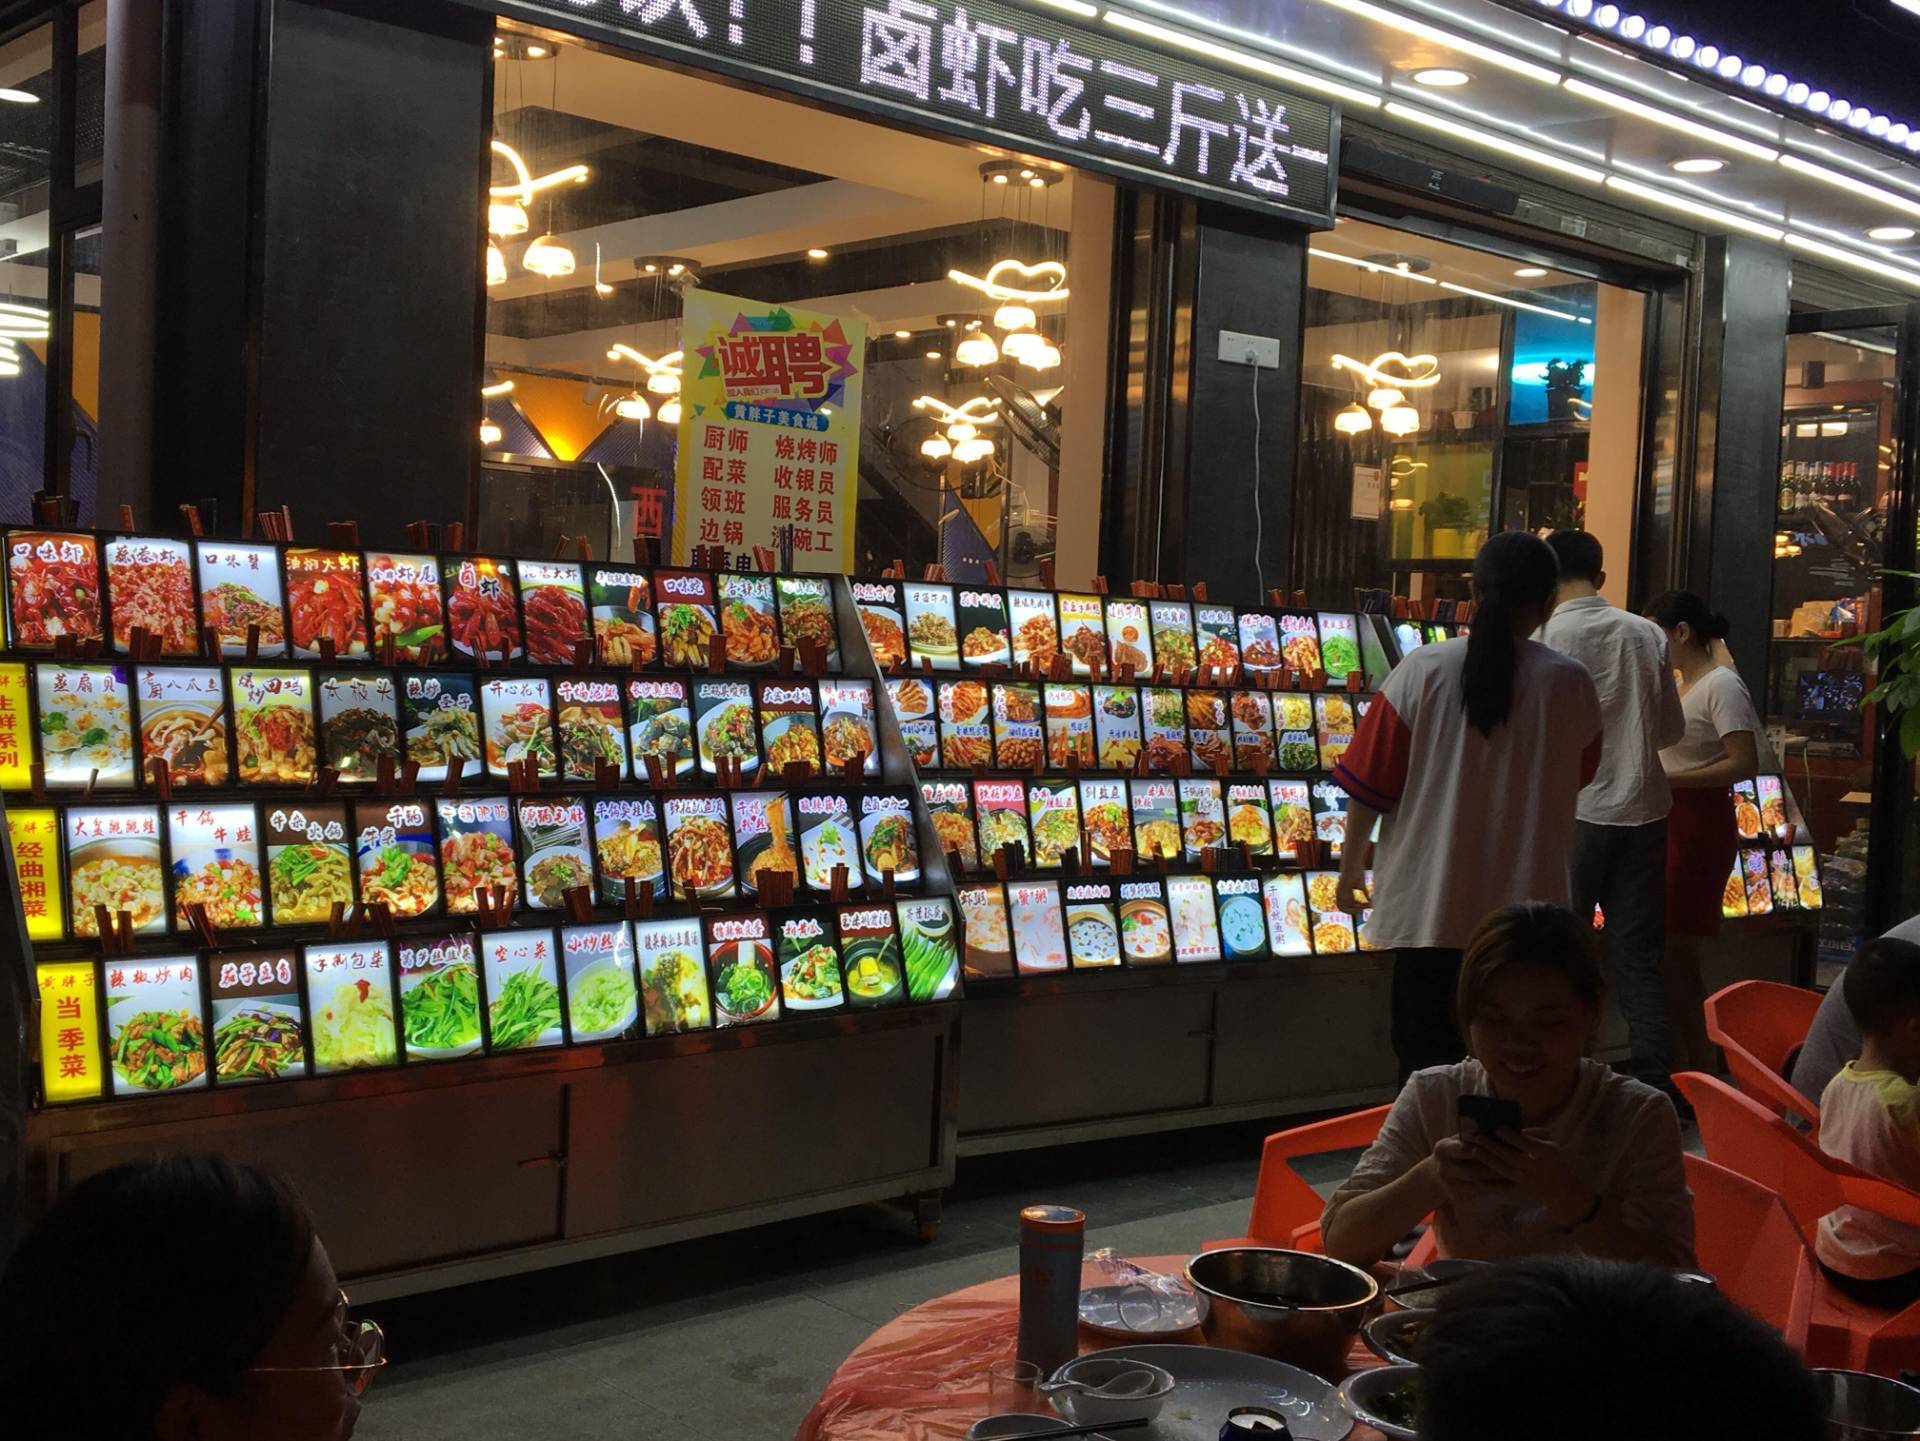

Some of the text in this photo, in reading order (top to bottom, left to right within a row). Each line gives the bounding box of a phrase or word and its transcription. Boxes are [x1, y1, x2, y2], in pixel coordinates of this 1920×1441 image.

[717, 332, 832, 396] 诚聘
[733, 404, 820, 430] 黄胖子美食城
[704, 424, 749, 455] 厨师
[775, 434, 838, 467] 烧烤师
[703, 455, 747, 485] 配菜
[774, 464, 835, 496] 收银员
[701, 486, 746, 515] 领班
[772, 495, 834, 525] 服务员
[700, 517, 744, 547] 边锅
[14, 542, 83, 565] 口味虾
[114, 546, 178, 565] 蒜蓉虾
[204, 553, 260, 570] 口味蟹
[286, 552, 361, 574] 油焖大虾
[53, 672, 116, 694] 蒸扇贝
[489, 681, 546, 699] 开心花甲
[74, 816, 157, 837] 大盆跳跳蛙
[175, 809, 253, 844] 干锅牛蛙
[16, 842, 47, 919] 经典湘菜
[313, 949, 385, 973] 手撕包菜
[494, 940, 549, 963] 空心菜
[41, 973, 97, 990] 黄胖子
[109, 965, 194, 989] 辣椒炒肉
[219, 958, 292, 989] 茄子豆角
[57, 996, 87, 1079] 当季菜
